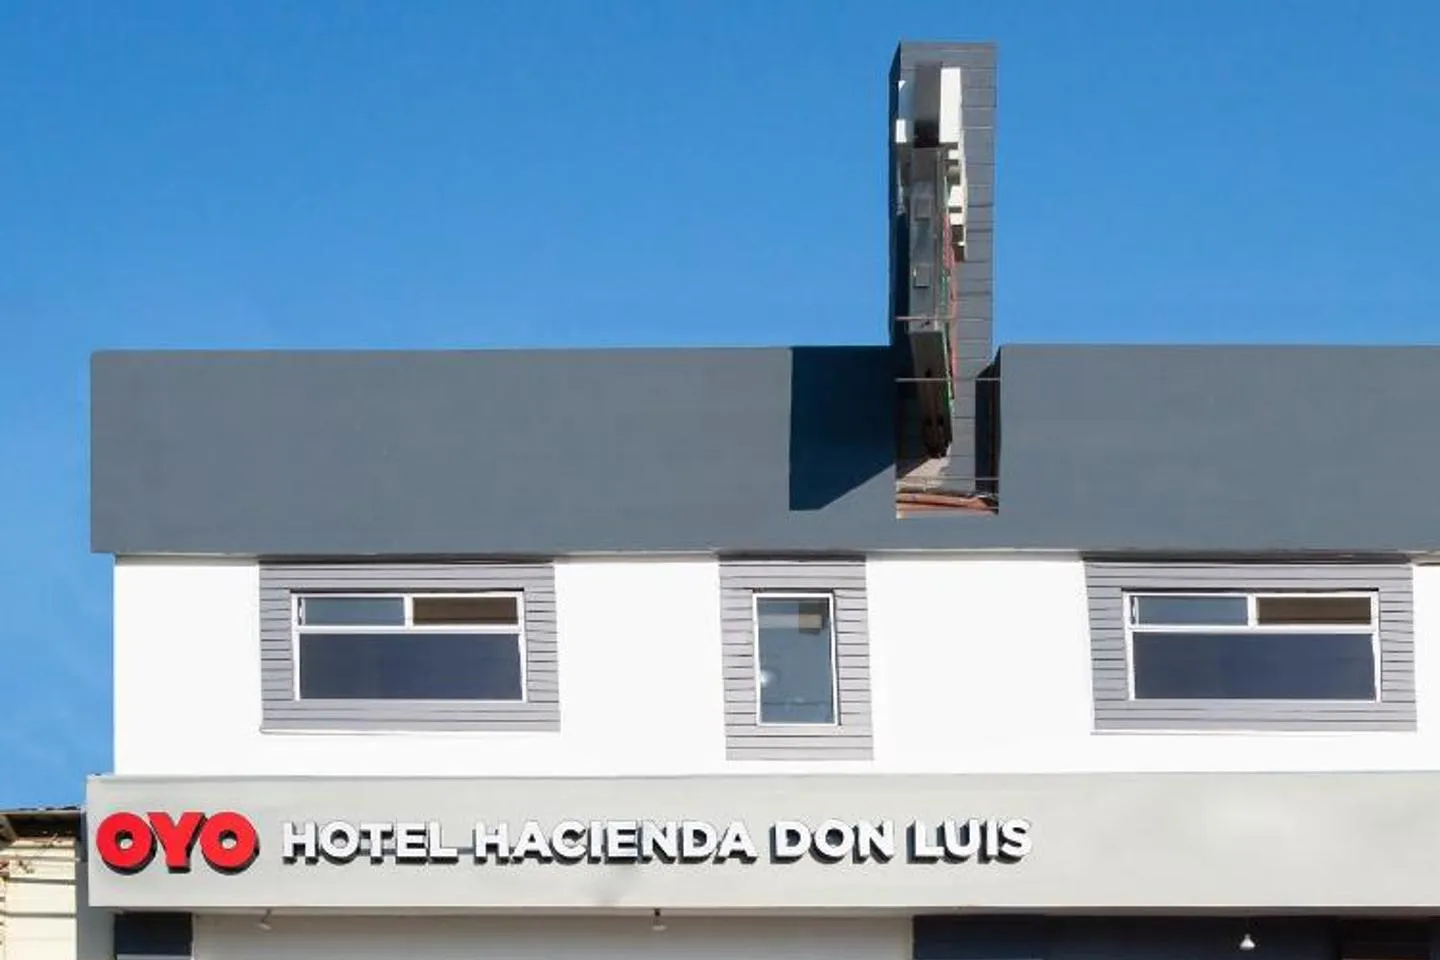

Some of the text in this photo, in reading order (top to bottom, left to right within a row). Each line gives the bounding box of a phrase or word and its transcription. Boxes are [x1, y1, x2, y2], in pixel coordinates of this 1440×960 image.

[96, 811, 1033, 873] OYO HOTEL HACIENDA DON LUIS
